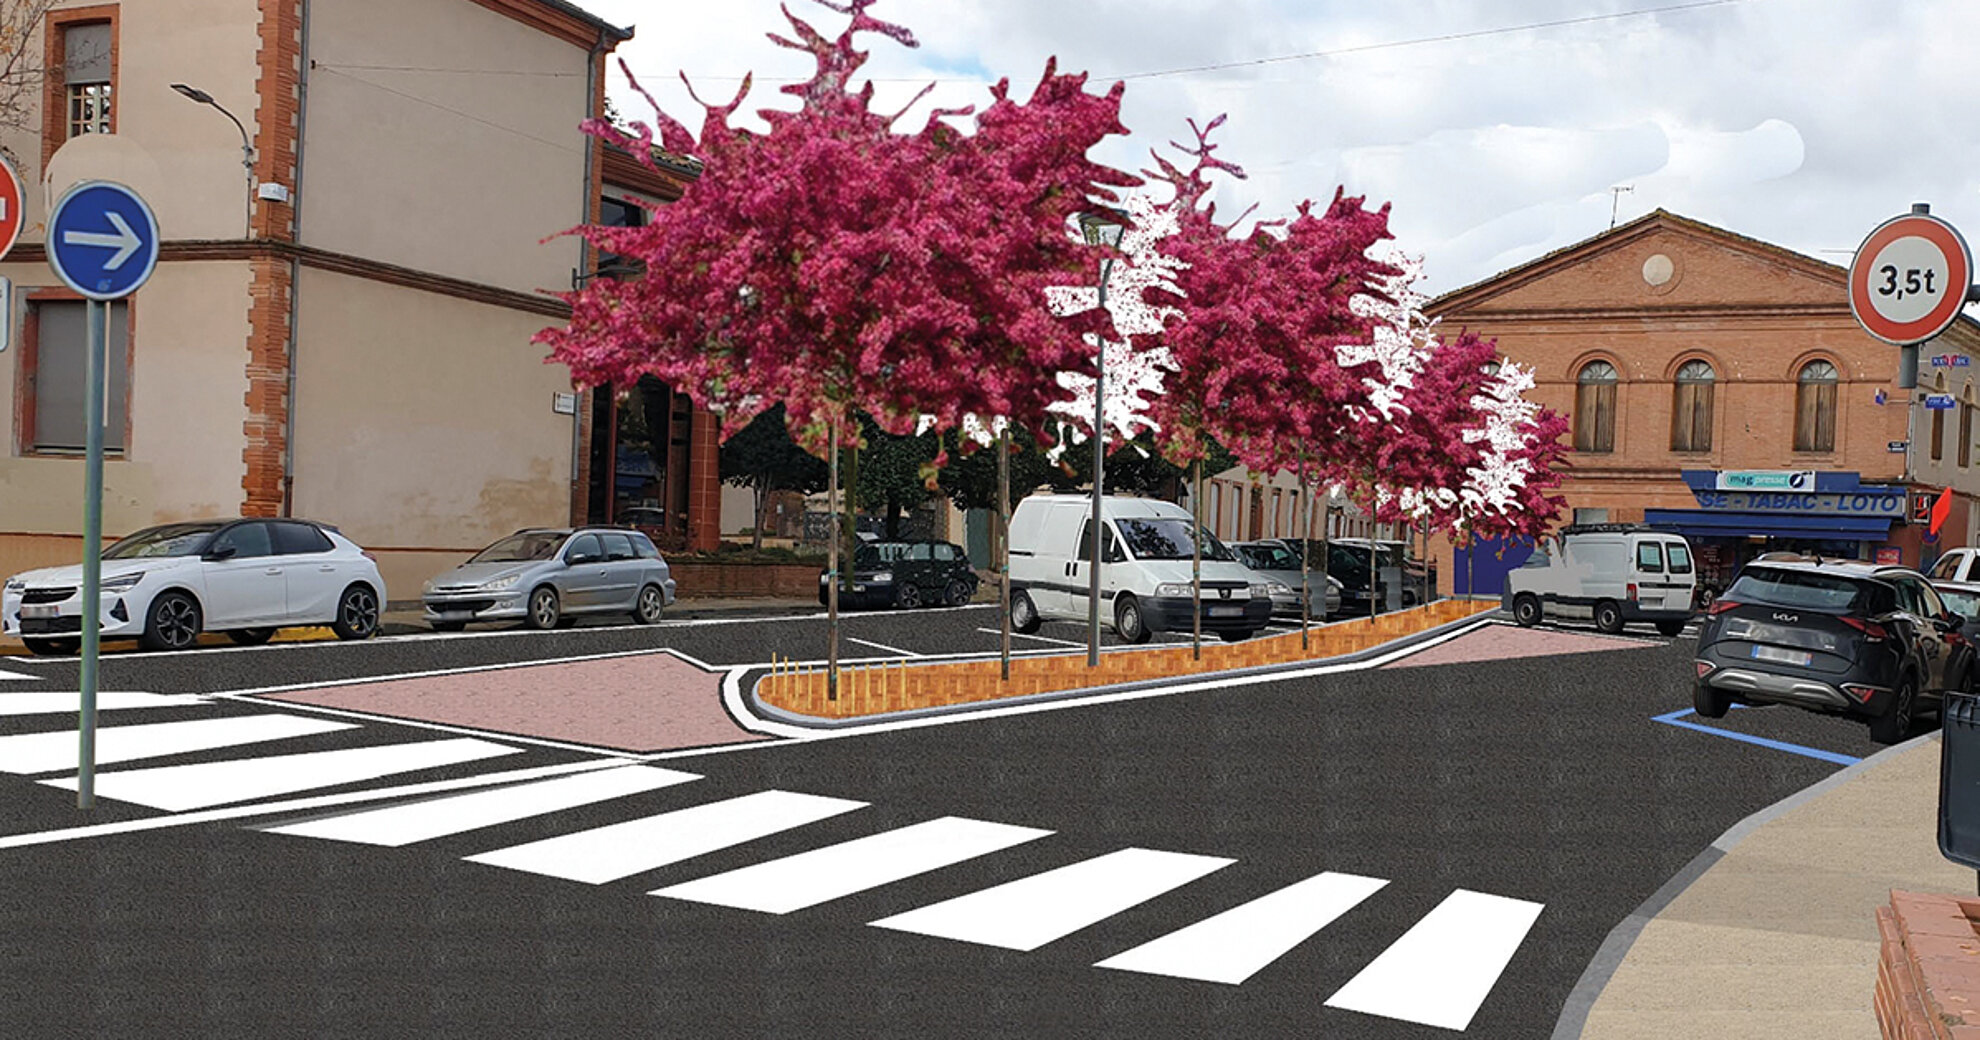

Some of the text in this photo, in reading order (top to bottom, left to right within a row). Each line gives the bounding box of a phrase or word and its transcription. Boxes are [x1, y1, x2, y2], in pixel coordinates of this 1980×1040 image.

[1878, 264, 1936, 301] 3,5t
[1697, 492, 1729, 508] SE
[1746, 492, 1818, 510] TABAC
[1837, 494, 1899, 512] LOTO
